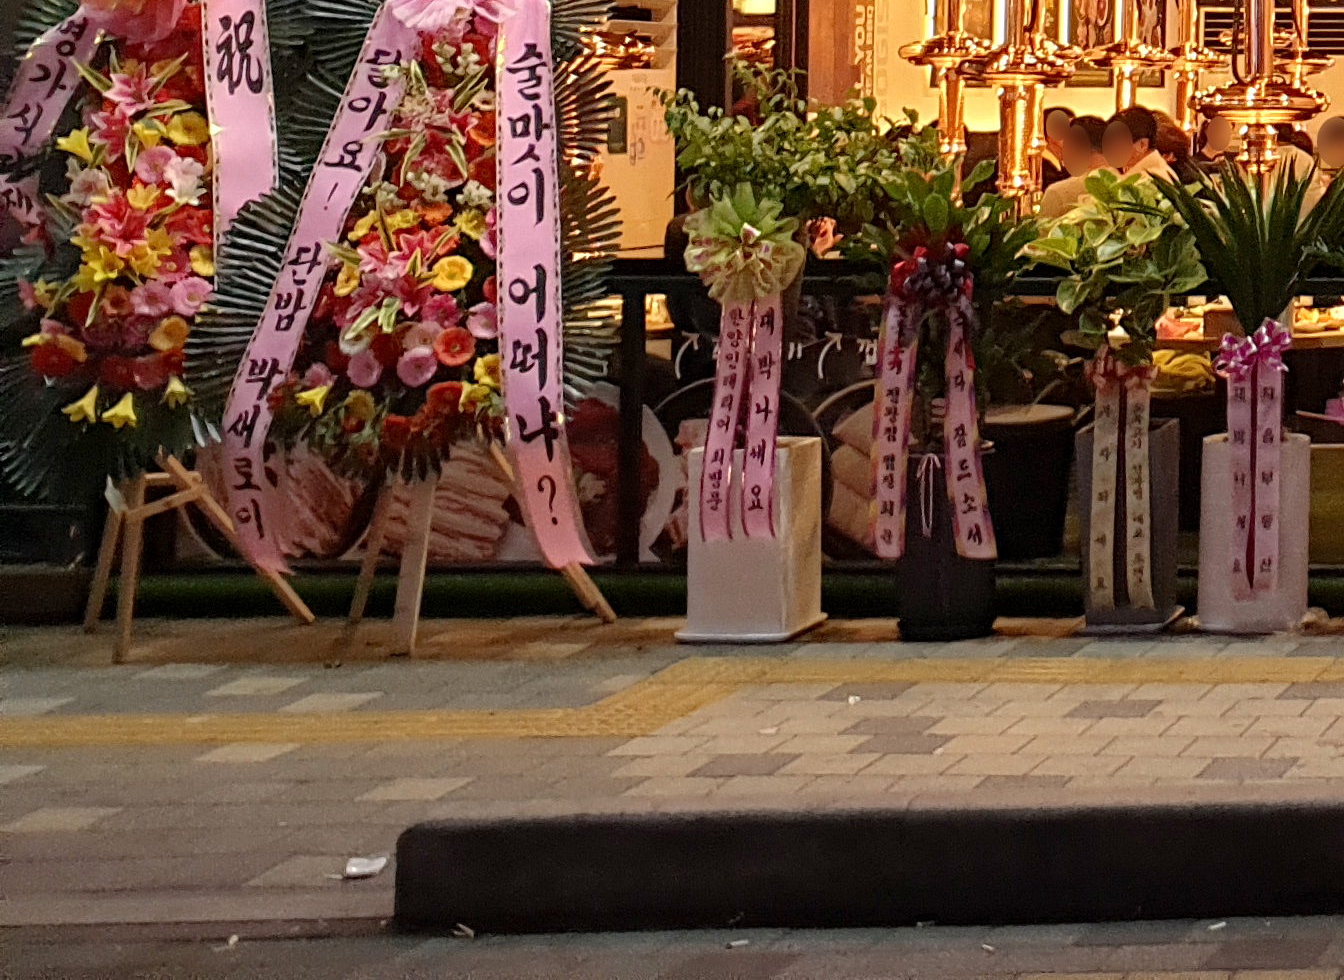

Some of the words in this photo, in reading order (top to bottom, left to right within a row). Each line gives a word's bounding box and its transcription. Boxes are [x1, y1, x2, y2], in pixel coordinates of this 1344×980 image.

[216, 8, 264, 96] 祝
[854, 4, 866, 64] YOU
[506, 42, 551, 227] 술맛이
[275, 241, 323, 333] 단밤
[228, 356, 285, 540] 박새로이
